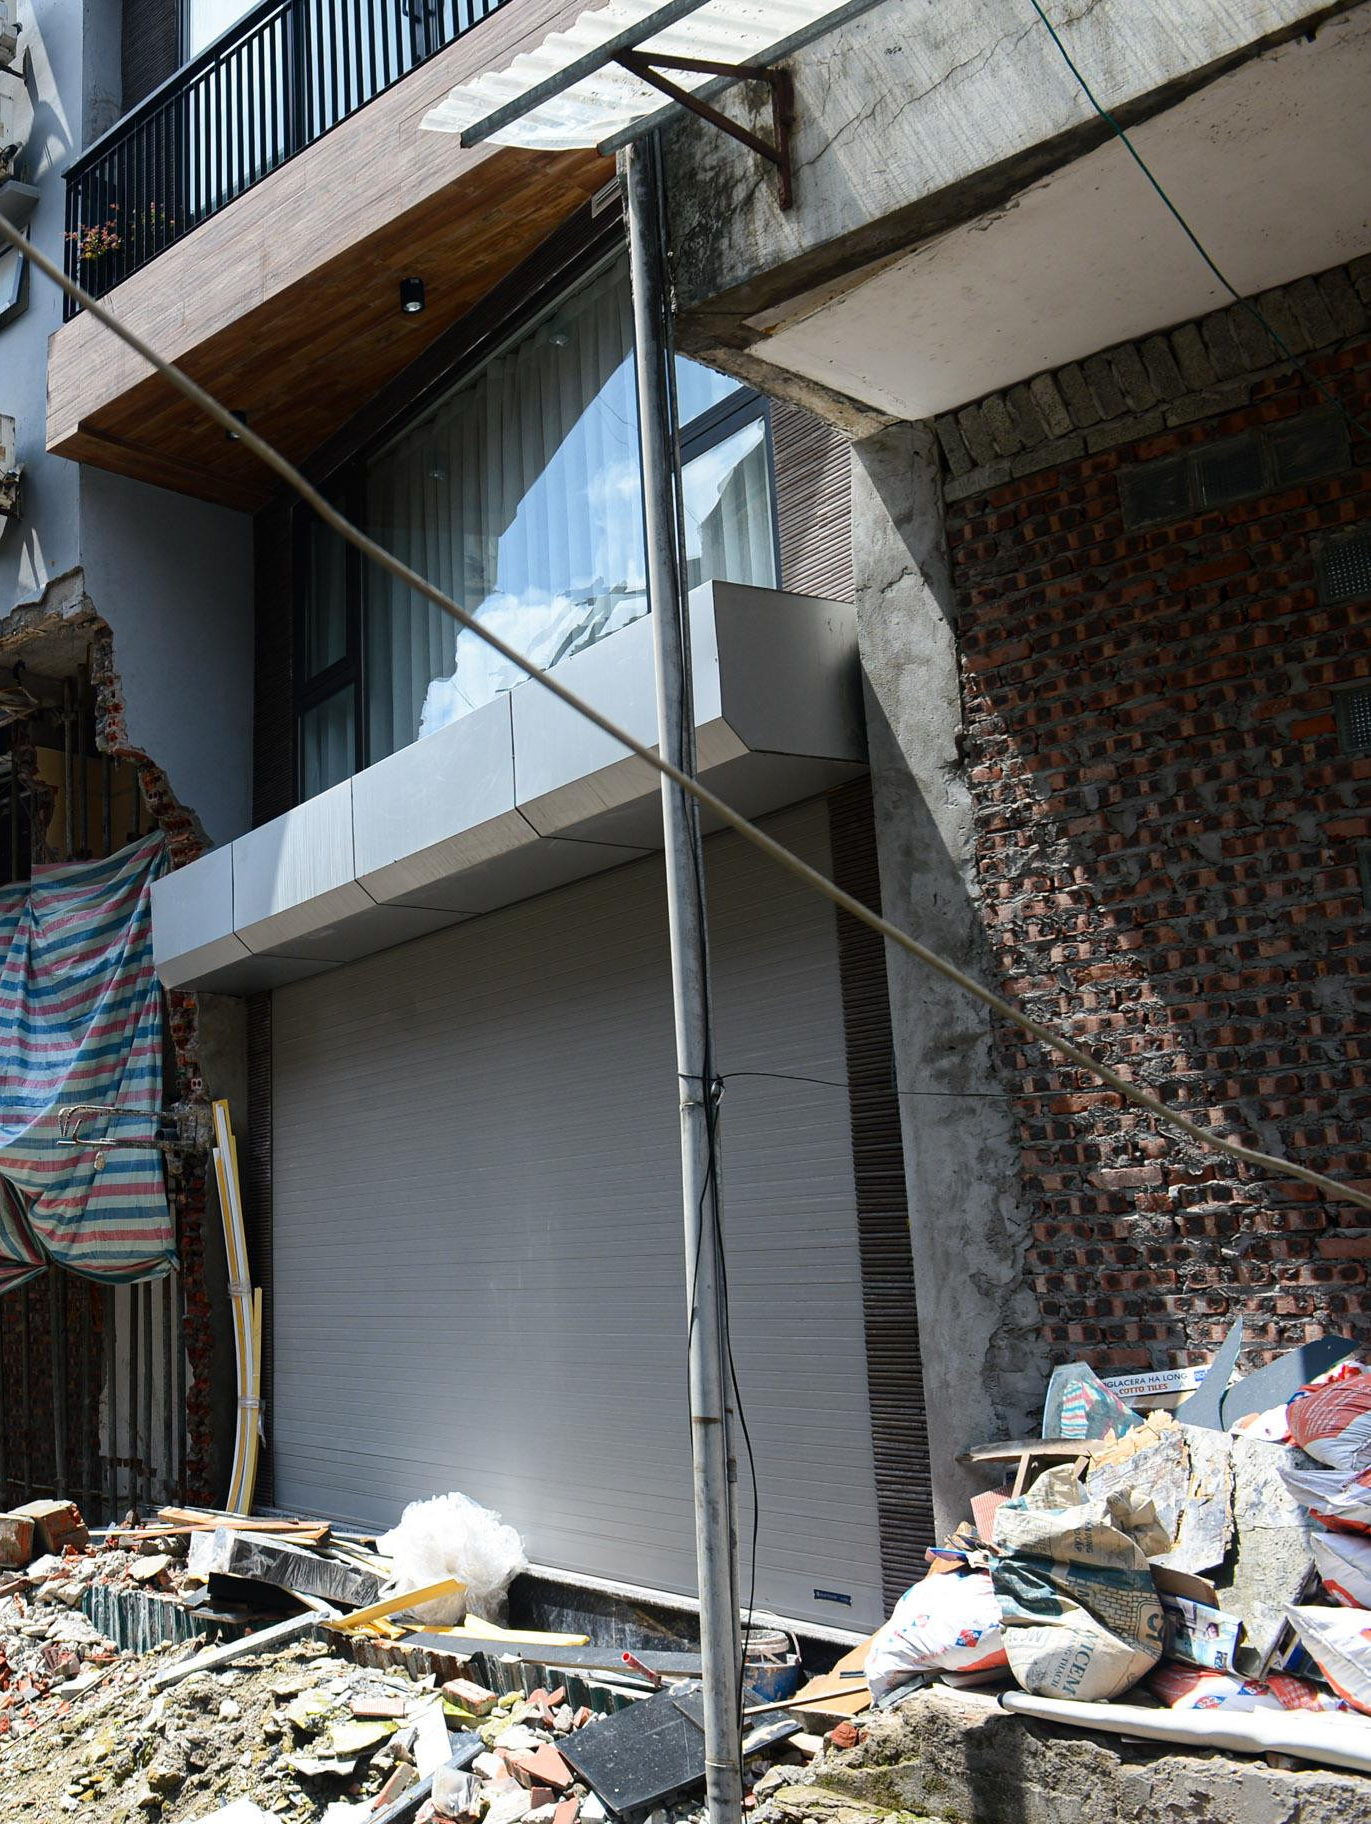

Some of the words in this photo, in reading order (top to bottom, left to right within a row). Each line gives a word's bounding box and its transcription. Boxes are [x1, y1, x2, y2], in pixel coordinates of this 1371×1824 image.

[1103, 1377, 1146, 1389] IGLACERA
[1163, 1372, 1188, 1381] LONG
[1119, 1386, 1145, 1395] COTTO
[1147, 1383, 1169, 1392] TILES
[1062, 1629, 1099, 1696] VICEM
